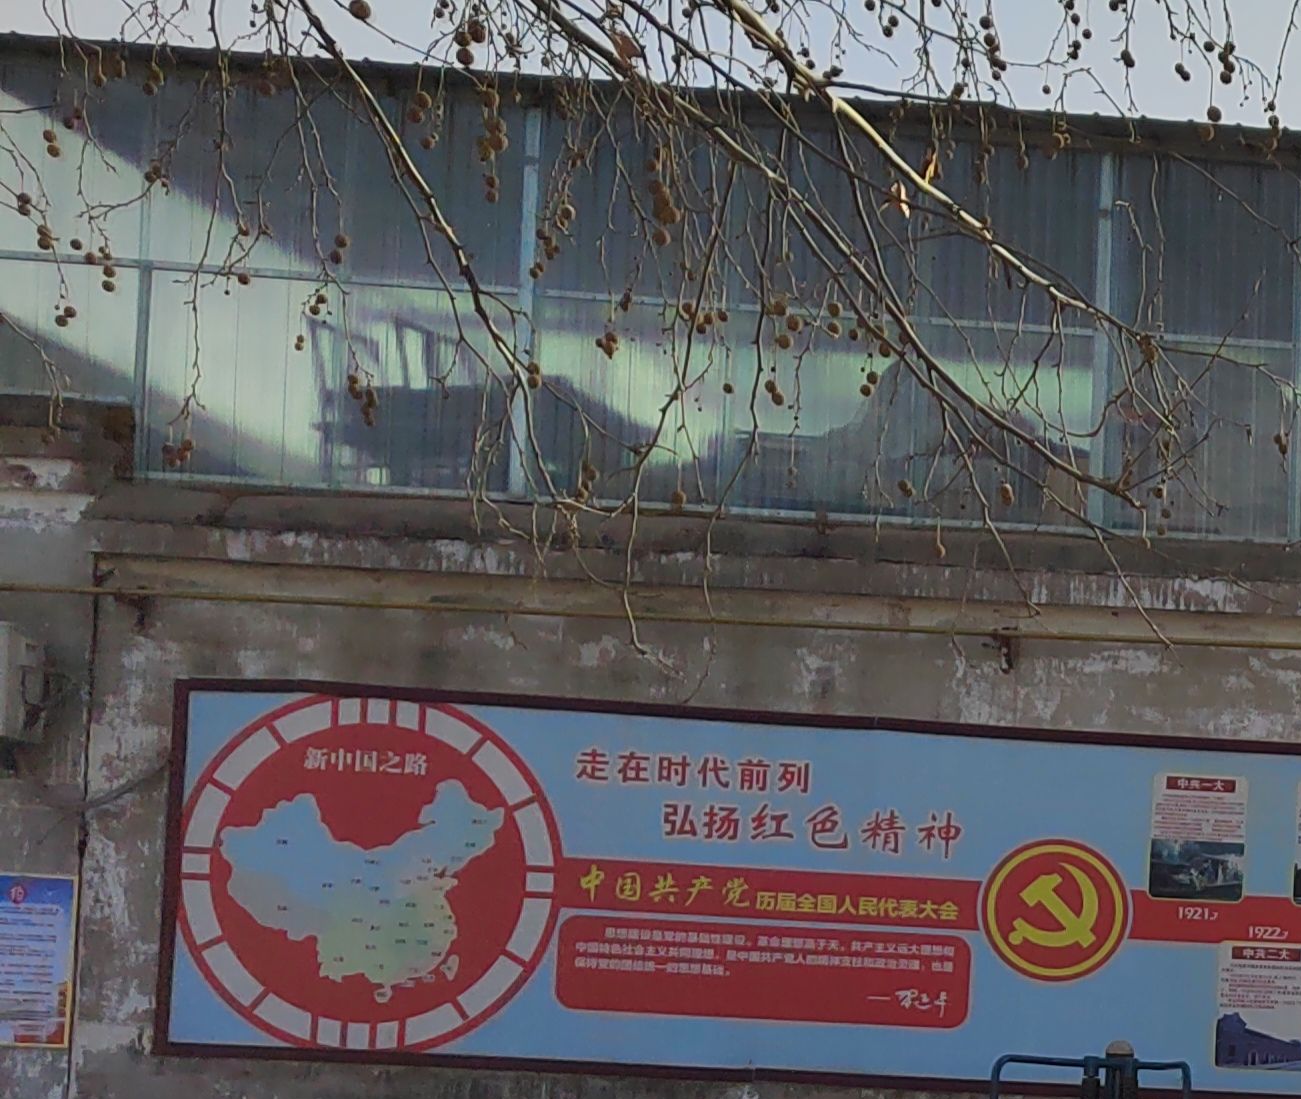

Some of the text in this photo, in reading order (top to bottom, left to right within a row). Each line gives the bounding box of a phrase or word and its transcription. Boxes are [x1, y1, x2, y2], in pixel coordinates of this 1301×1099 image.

[303, 746, 429, 776] 新中国之路
[576, 748, 810, 794] 走在时代前列
[1177, 776, 1224, 792] 中共一大
[663, 802, 963, 860] 弘扬红色精神
[579, 864, 959, 922] 中国共产党 历届全国人民代表大会
[1178, 906, 1218, 921] 1921.7
[1248, 926, 1288, 939] 1922.7
[1243, 948, 1290, 960] 中共二大
